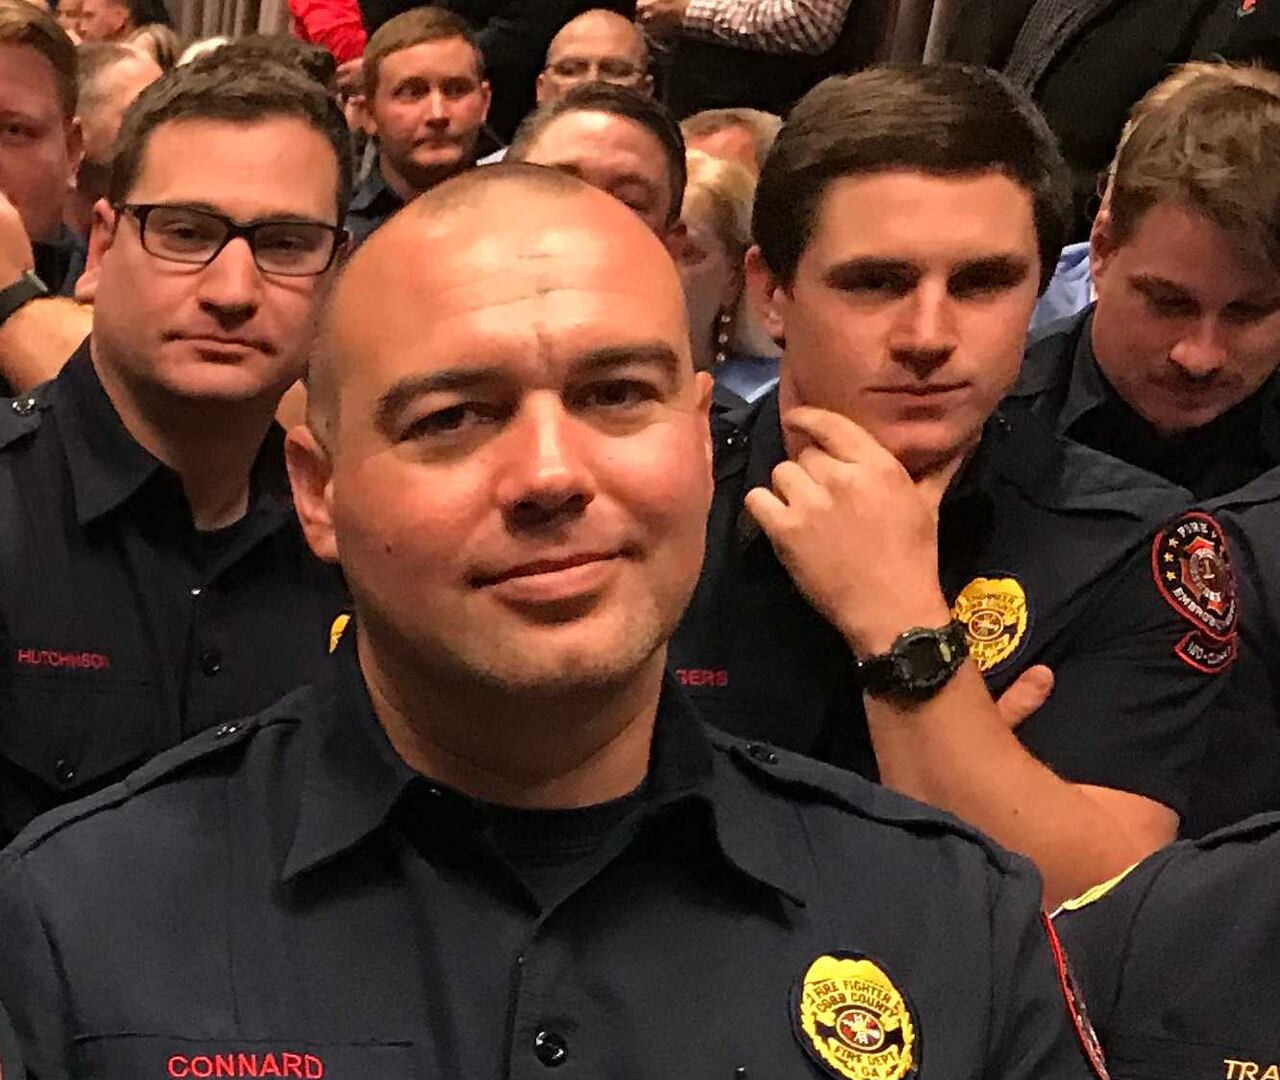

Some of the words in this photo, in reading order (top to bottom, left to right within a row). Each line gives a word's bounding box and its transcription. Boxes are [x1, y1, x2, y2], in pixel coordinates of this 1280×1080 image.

[813, 982, 839, 997] FIRE
[843, 980, 891, 1003] FIGHTER
[816, 993, 846, 1013] COBB
[851, 992, 899, 1018] COUNTY
[168, 1053, 323, 1079] CONNARD
[861, 1066, 880, 1078] GA
